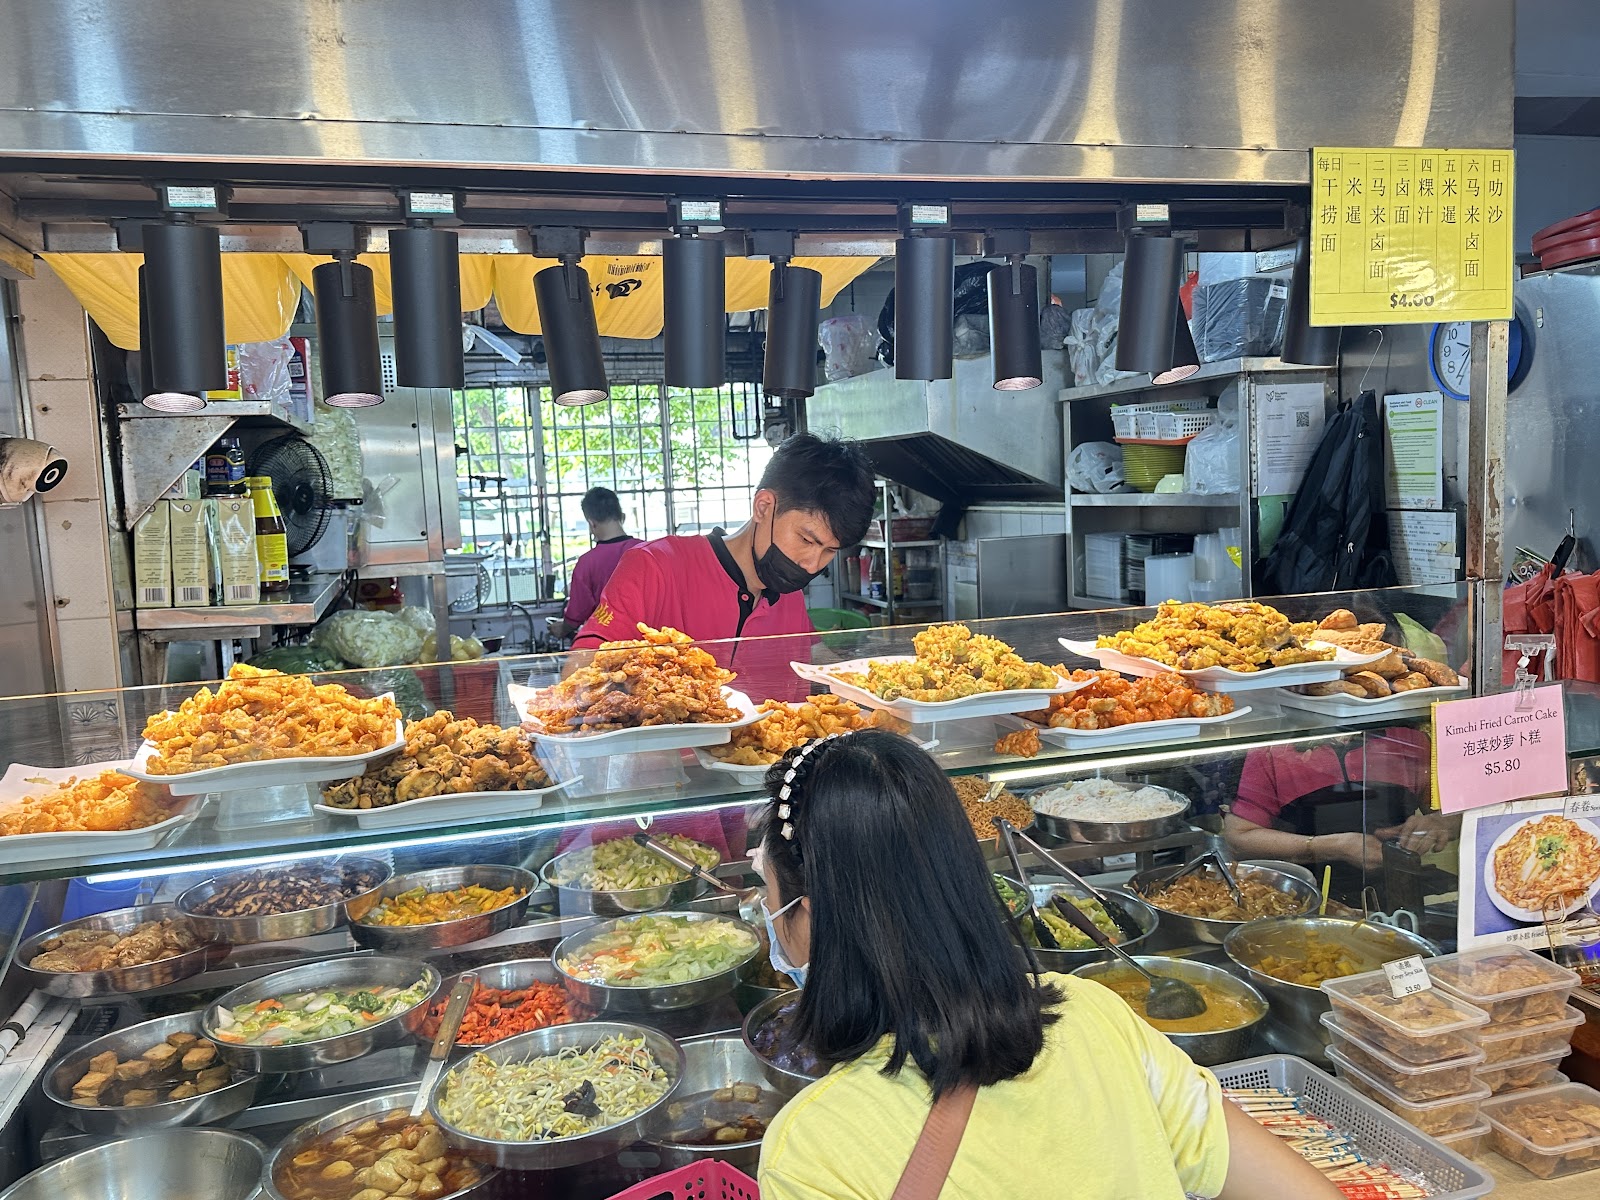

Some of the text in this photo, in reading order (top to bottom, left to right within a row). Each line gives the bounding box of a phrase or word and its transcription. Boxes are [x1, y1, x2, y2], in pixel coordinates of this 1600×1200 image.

[1317, 157, 1341, 172] 每日
[1372, 160, 1385, 172] 二
[1396, 160, 1409, 172] 三
[1421, 160, 1432, 172] 四
[1444, 160, 1456, 172] 五
[1467, 160, 1480, 172] 六
[1492, 160, 1502, 173] 日
[1345, 177, 1362, 225] 米暹
[1394, 177, 1410, 225] 卤面
[1417, 177, 1434, 225] 粿汁
[1441, 177, 1458, 225] 米暹
[1488, 178, 1504, 224] 叻沙
[1320, 178, 1338, 253] 干捞面
[1369, 177, 1387, 280] 马来卤面
[1464, 178, 1481, 278] 马来卤面
[1390, 292, 1435, 308] $4.00
[1447, 328, 1458, 341] 10
[1443, 345, 1451, 358] 9
[1447, 361, 1455, 374] 8
[1445, 708, 1558, 737] Kimchi Fried Carrot Cake
[1463, 729, 1542, 757] 泡菜炒萝卜糕
[1484, 758, 1521, 776] $5.80
